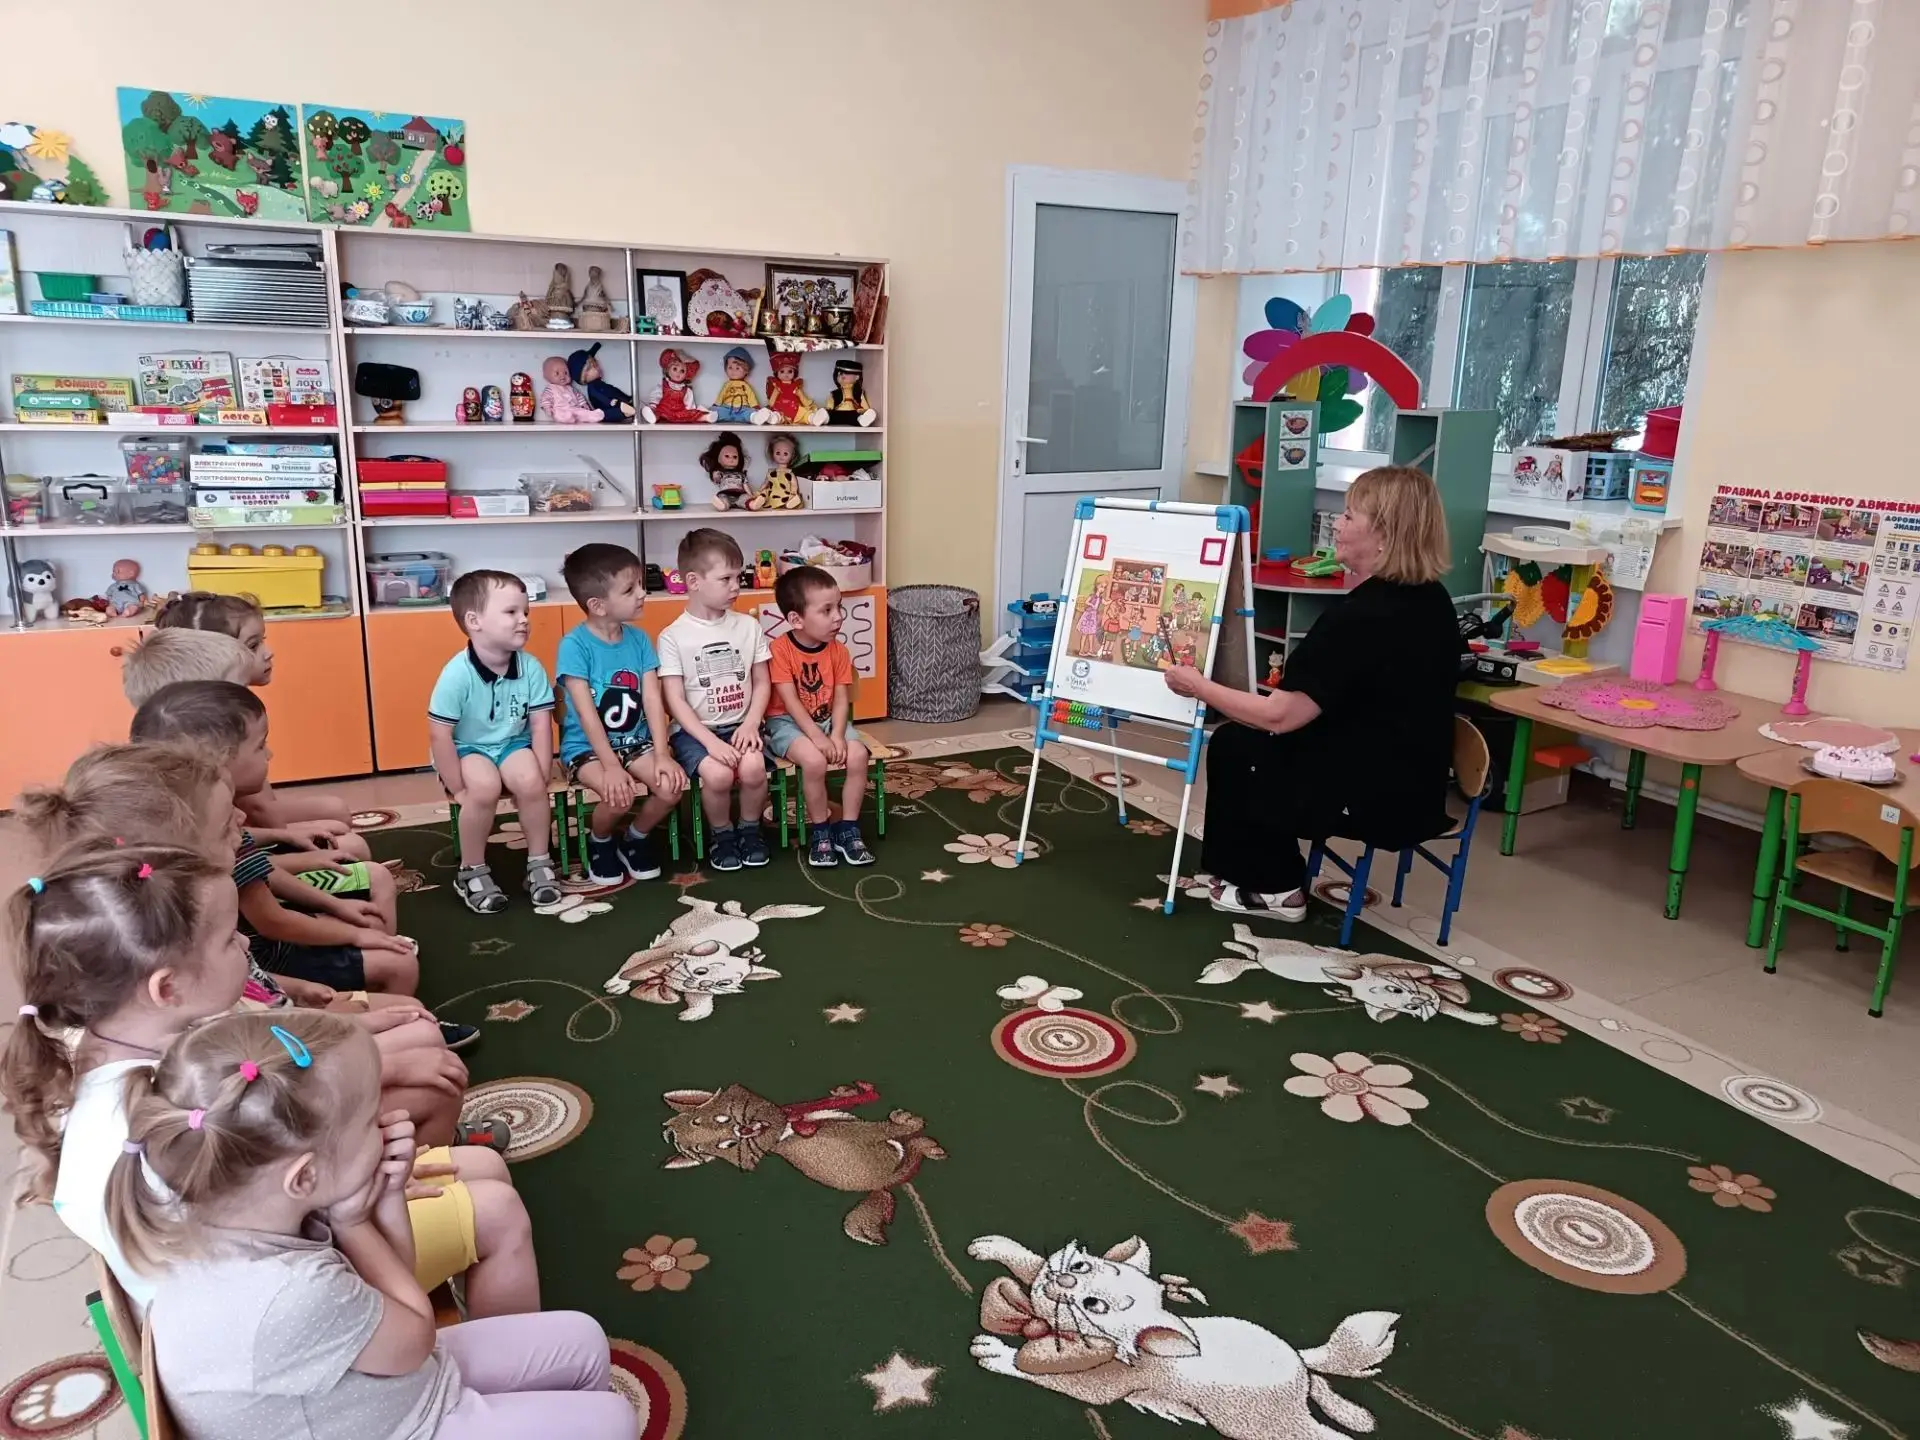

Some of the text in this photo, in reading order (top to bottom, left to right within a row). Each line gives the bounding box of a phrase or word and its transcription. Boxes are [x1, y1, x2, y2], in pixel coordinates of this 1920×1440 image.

[296, 380, 323, 388] ЛОТО
[1717, 485, 1771, 500] ПРАВИЛА
[1773, 491, 1854, 507] ДОРОЖНОГО
[715, 683, 742, 695] PARK
[717, 691, 744, 704] LEISURE
